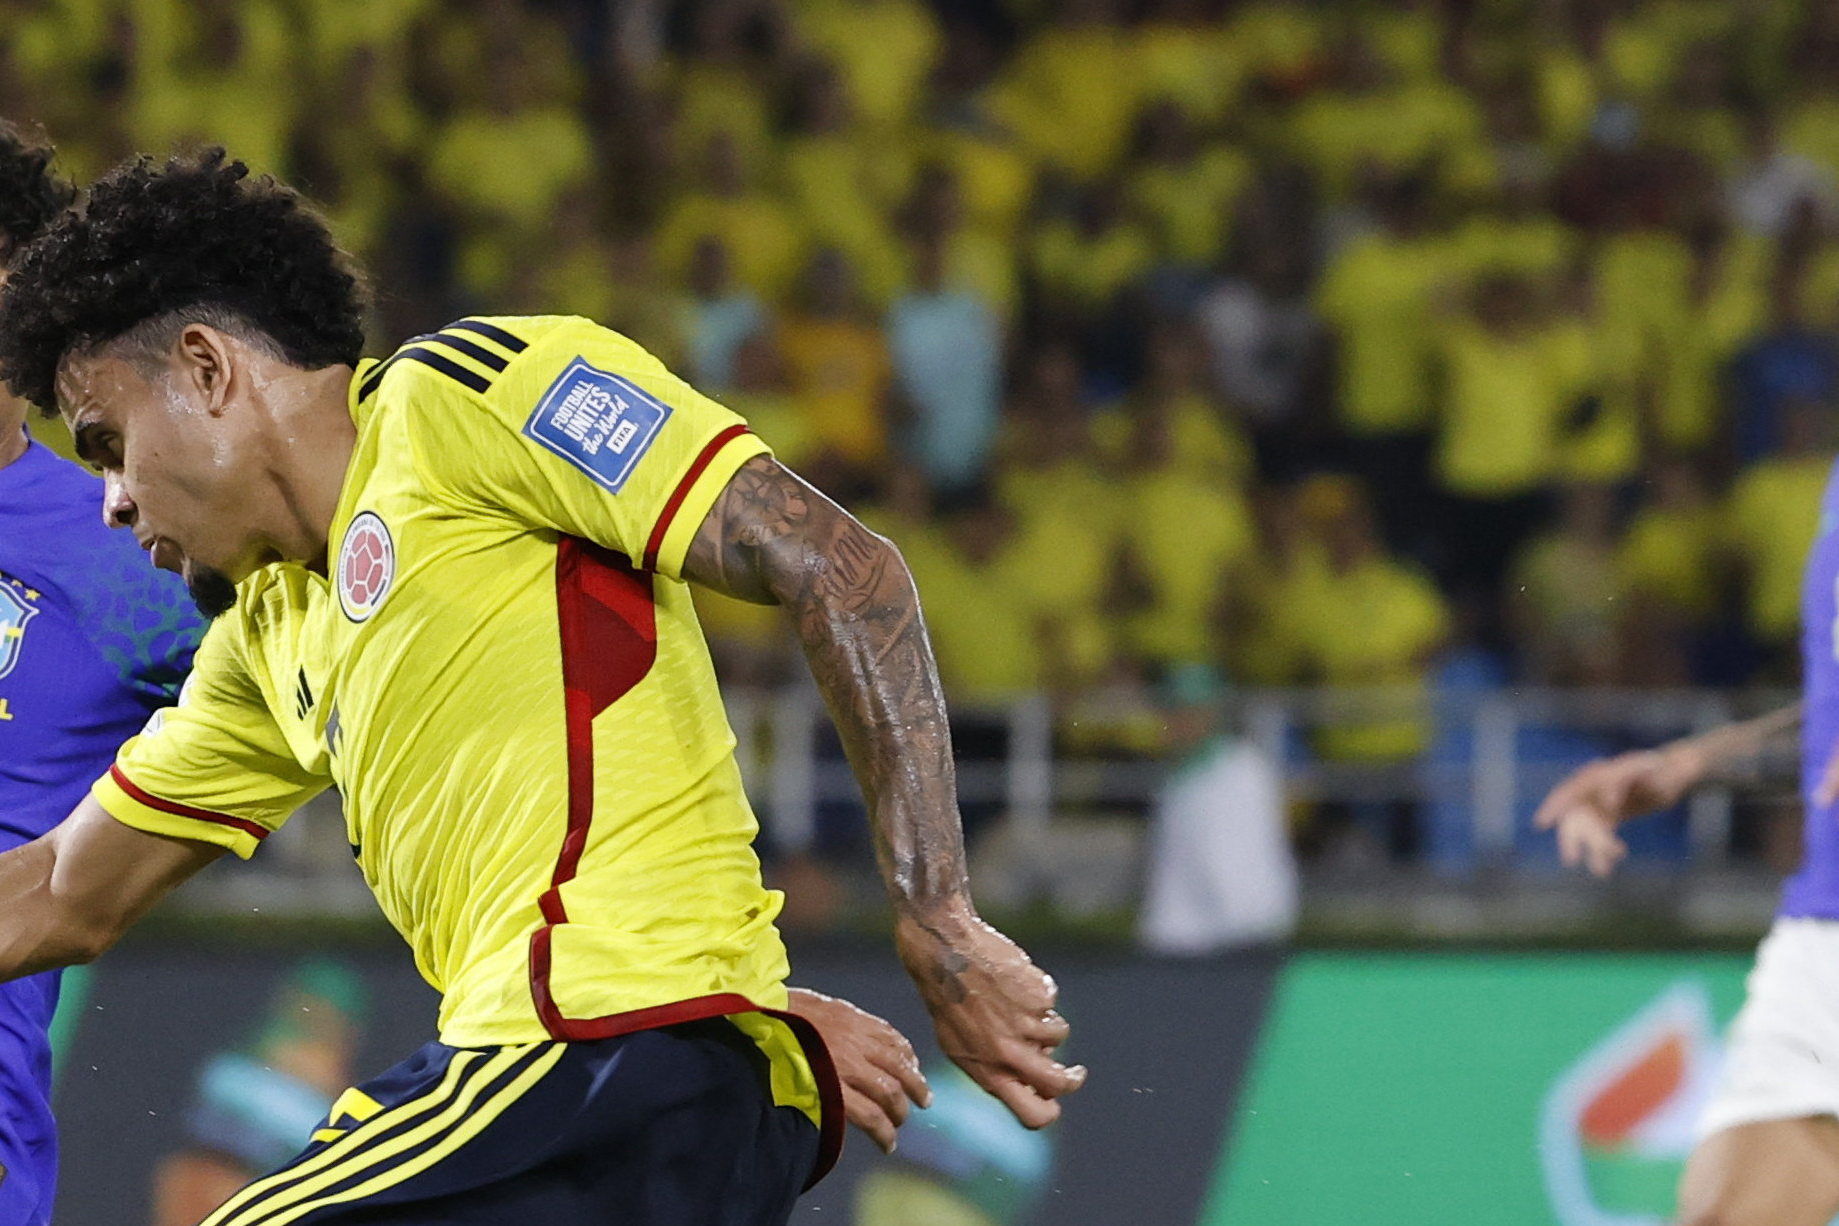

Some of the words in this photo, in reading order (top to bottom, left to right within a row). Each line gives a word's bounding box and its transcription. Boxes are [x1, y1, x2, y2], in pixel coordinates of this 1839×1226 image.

[550, 380, 594, 431] FOOTBALL
[563, 386, 611, 442] UNITES
[582, 431, 604, 455] the
[593, 394, 630, 436] World
[613, 426, 632, 448] FIFA
